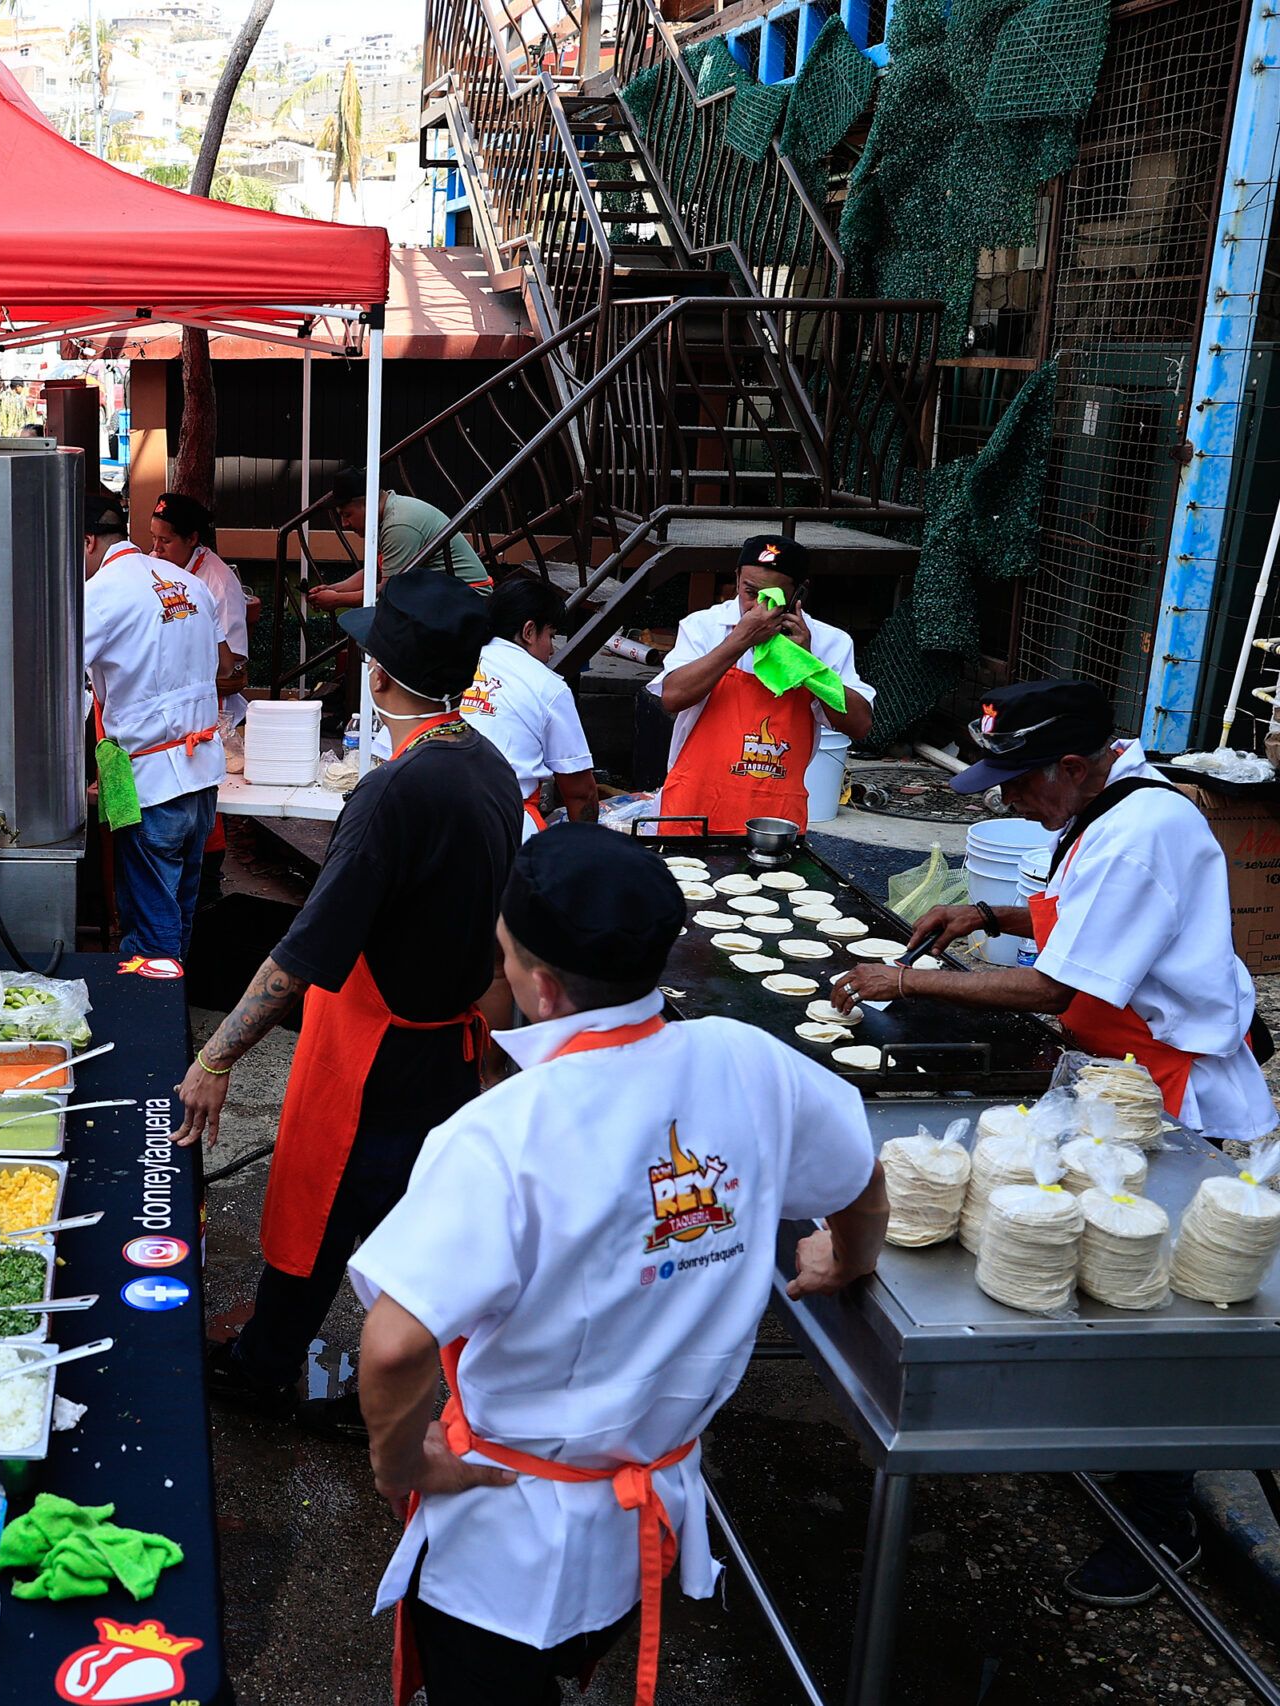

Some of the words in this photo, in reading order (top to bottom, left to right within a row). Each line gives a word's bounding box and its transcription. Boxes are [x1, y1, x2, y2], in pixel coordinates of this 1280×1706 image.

[742, 741, 790, 764] REY
[132, 1098, 181, 1230] donreytaqueria
[652, 1157, 727, 1220] REY
[724, 1178, 739, 1192] MR
[677, 1242, 745, 1271] donreytaqueria
